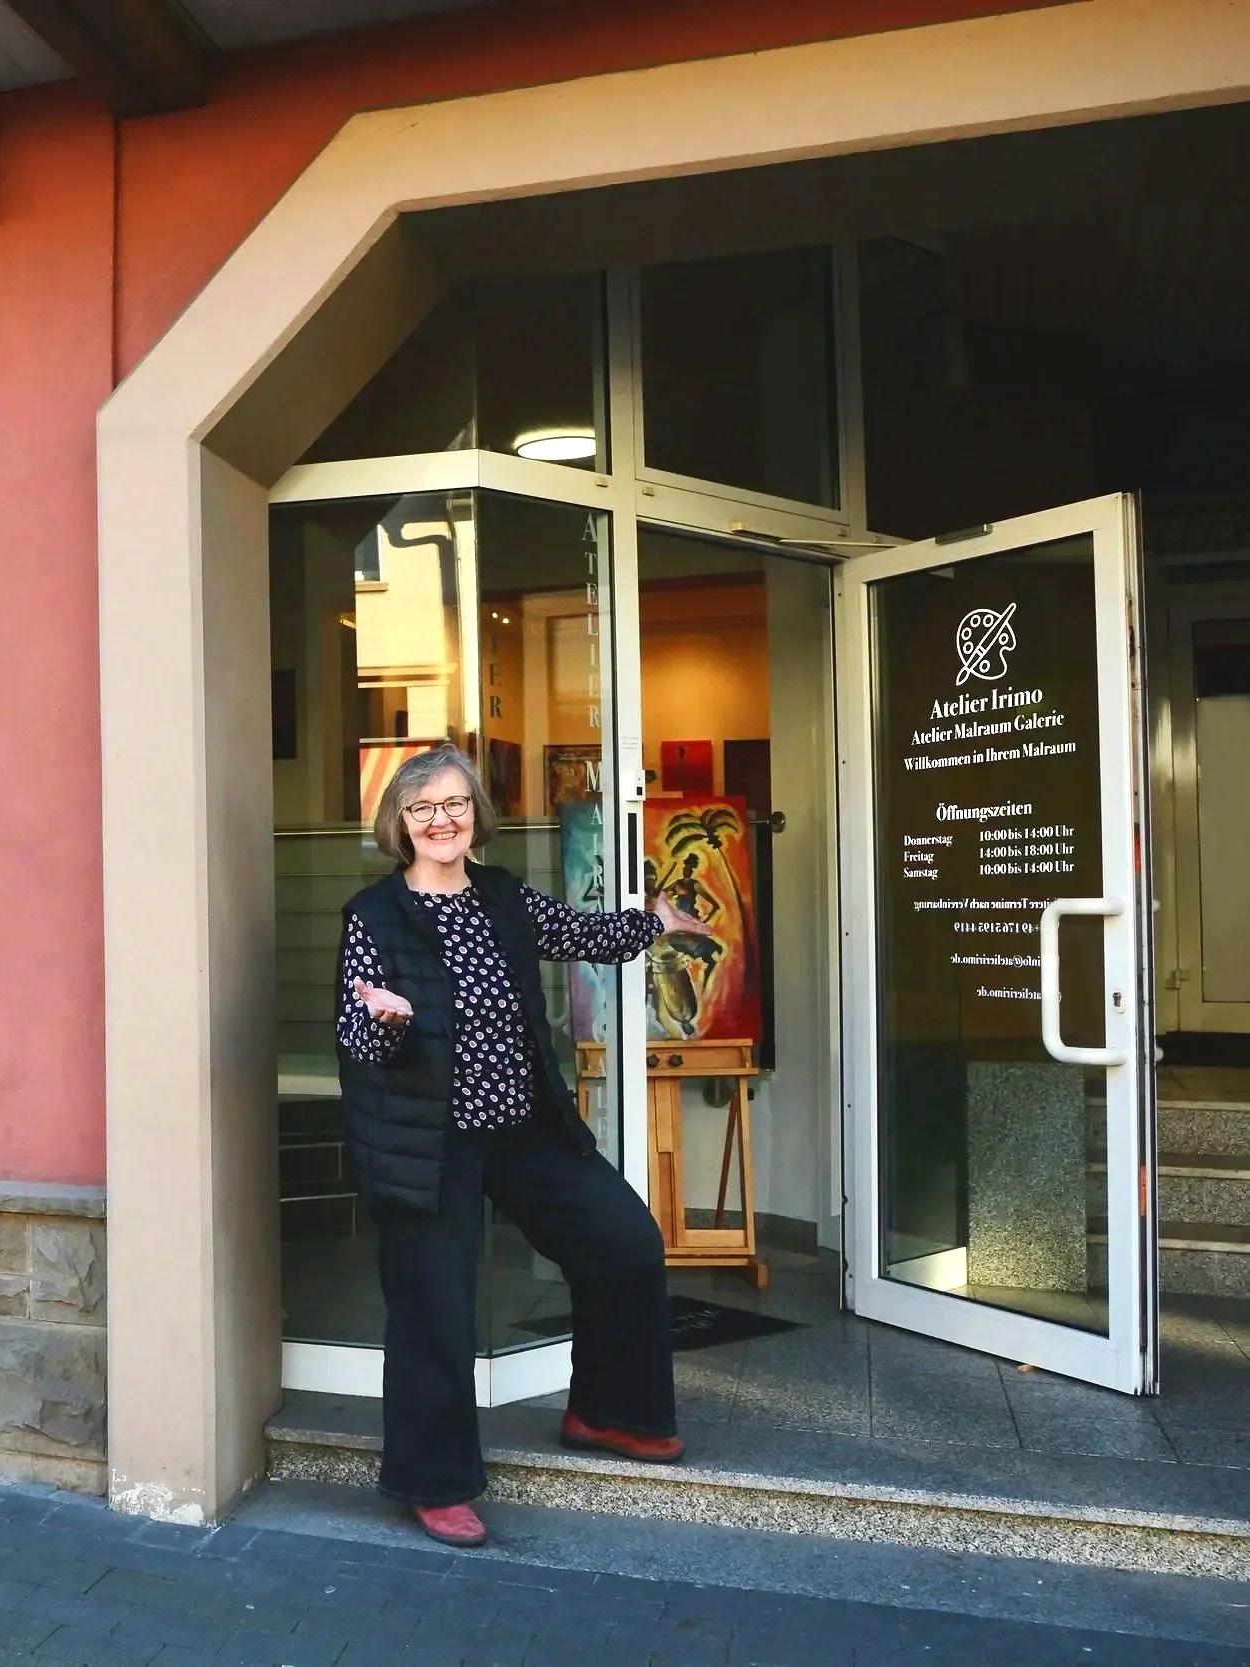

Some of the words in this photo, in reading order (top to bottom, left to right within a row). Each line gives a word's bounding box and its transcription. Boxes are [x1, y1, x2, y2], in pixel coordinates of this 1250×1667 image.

[582, 512, 601, 728] ATELIER
[930, 694, 988, 719] Atelier
[991, 687, 1043, 710] Irimo
[911, 727, 953, 745] Atelier
[954, 722, 1012, 740] Malraum
[1014, 710, 1065, 731] Galerie
[904, 754, 971, 771] Willkommen
[973, 750, 983, 764] in
[986, 746, 1021, 762] Ihrem
[1022, 741, 1076, 758] Malraum
[936, 801, 1032, 822] Öffnungszeiten
[904, 834, 953, 846] Donnerstag
[979, 830, 1007, 842] 10:00
[1008, 828, 1022, 840] bis
[1024, 826, 1053, 839] 14:00
[1055, 825, 1074, 838] Uhr
[904, 851, 934, 864] Freitag
[979, 848, 1007, 859] 14:00
[1008, 846, 1022, 858] bis
[1024, 845, 1053, 857] 18:00
[1055, 843, 1074, 856] Uhr
[904, 867, 938, 880] Samstag
[979, 864, 1007, 875] 10:00
[1008, 863, 1022, 874] bis
[1024, 861, 1053, 874] 14:00
[1055, 861, 1074, 873] Uhr
